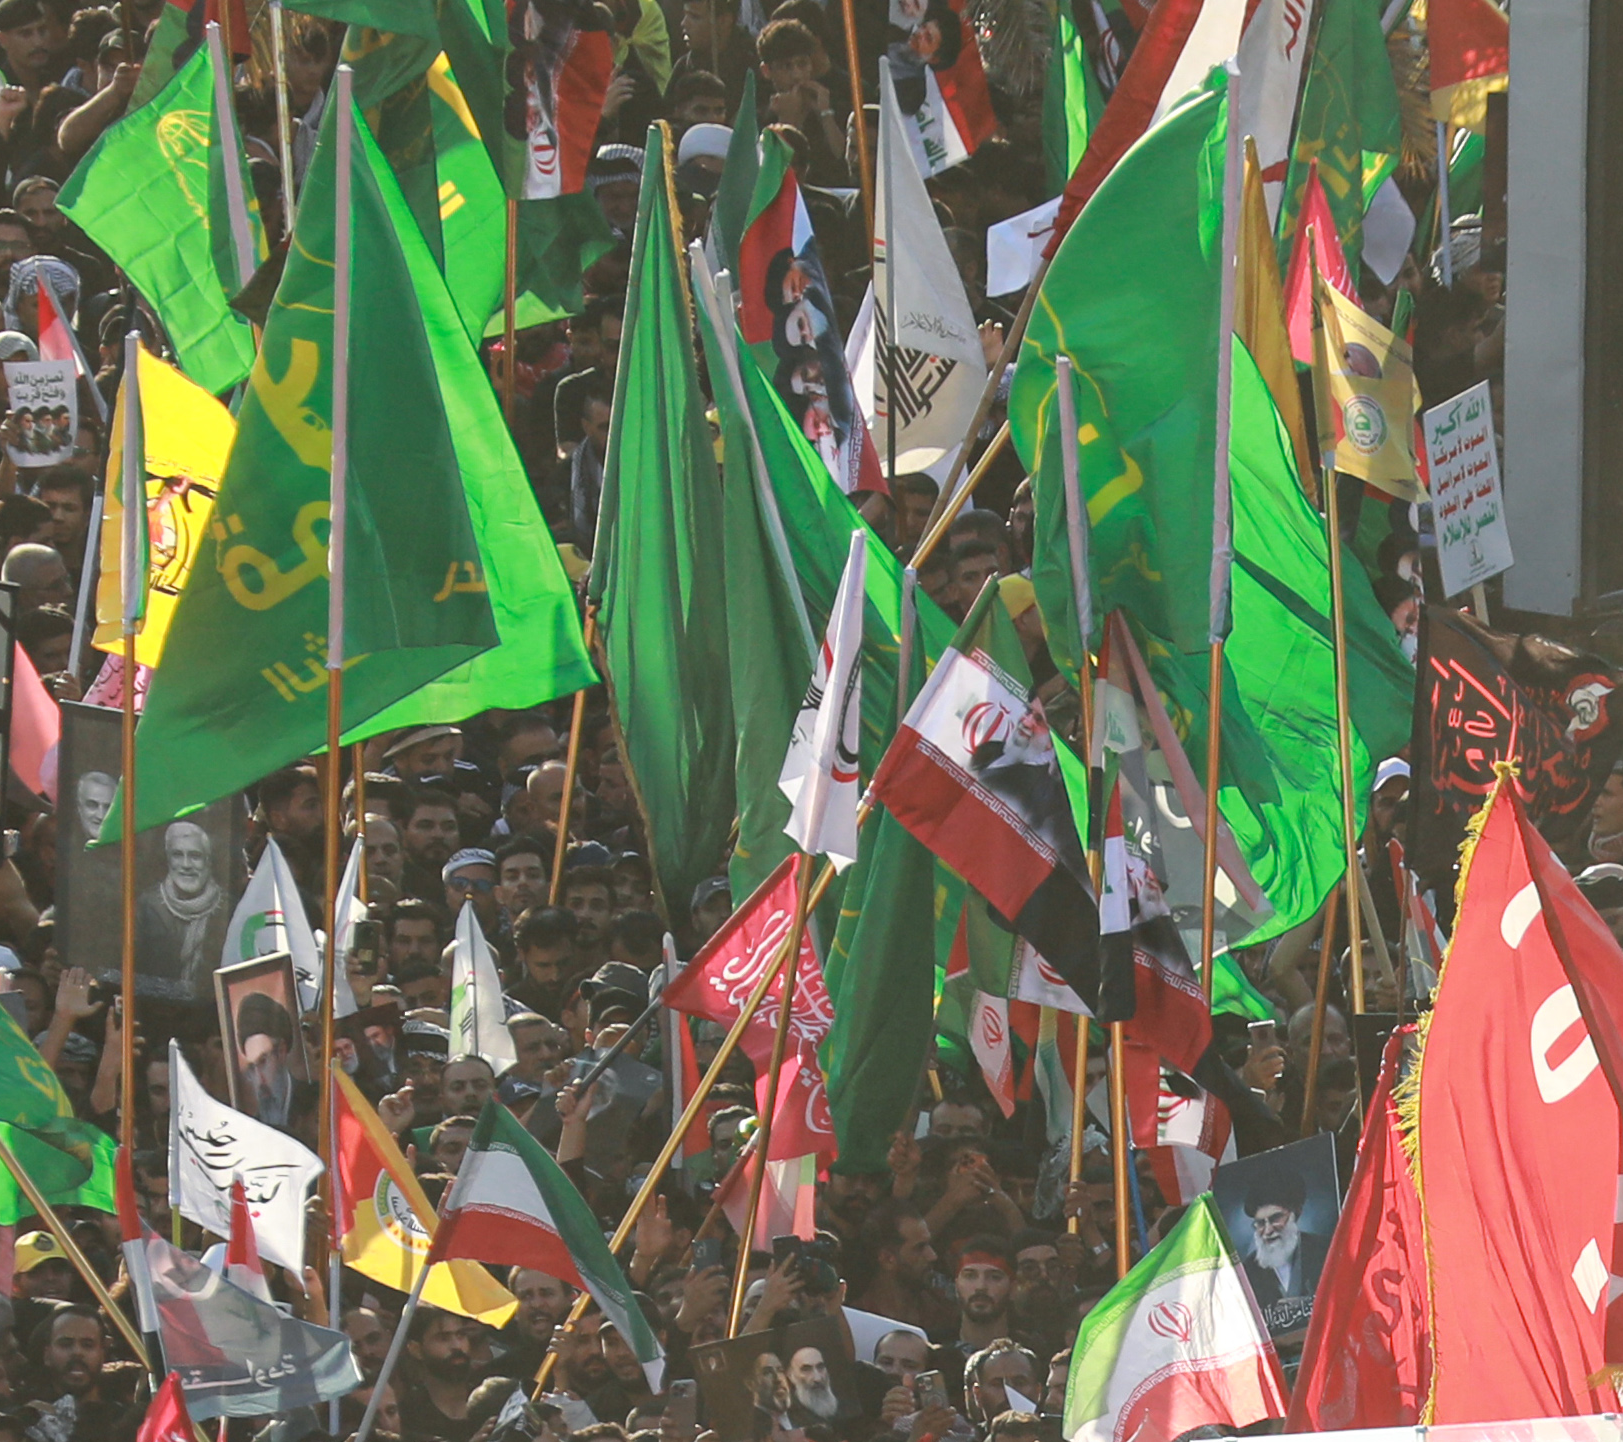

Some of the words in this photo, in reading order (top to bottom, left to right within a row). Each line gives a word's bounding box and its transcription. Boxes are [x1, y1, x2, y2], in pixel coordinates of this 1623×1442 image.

[1465, 395, 1486, 424] الله
[1464, 425, 1490, 452] الموت
[1467, 451, 1492, 477] الموت
